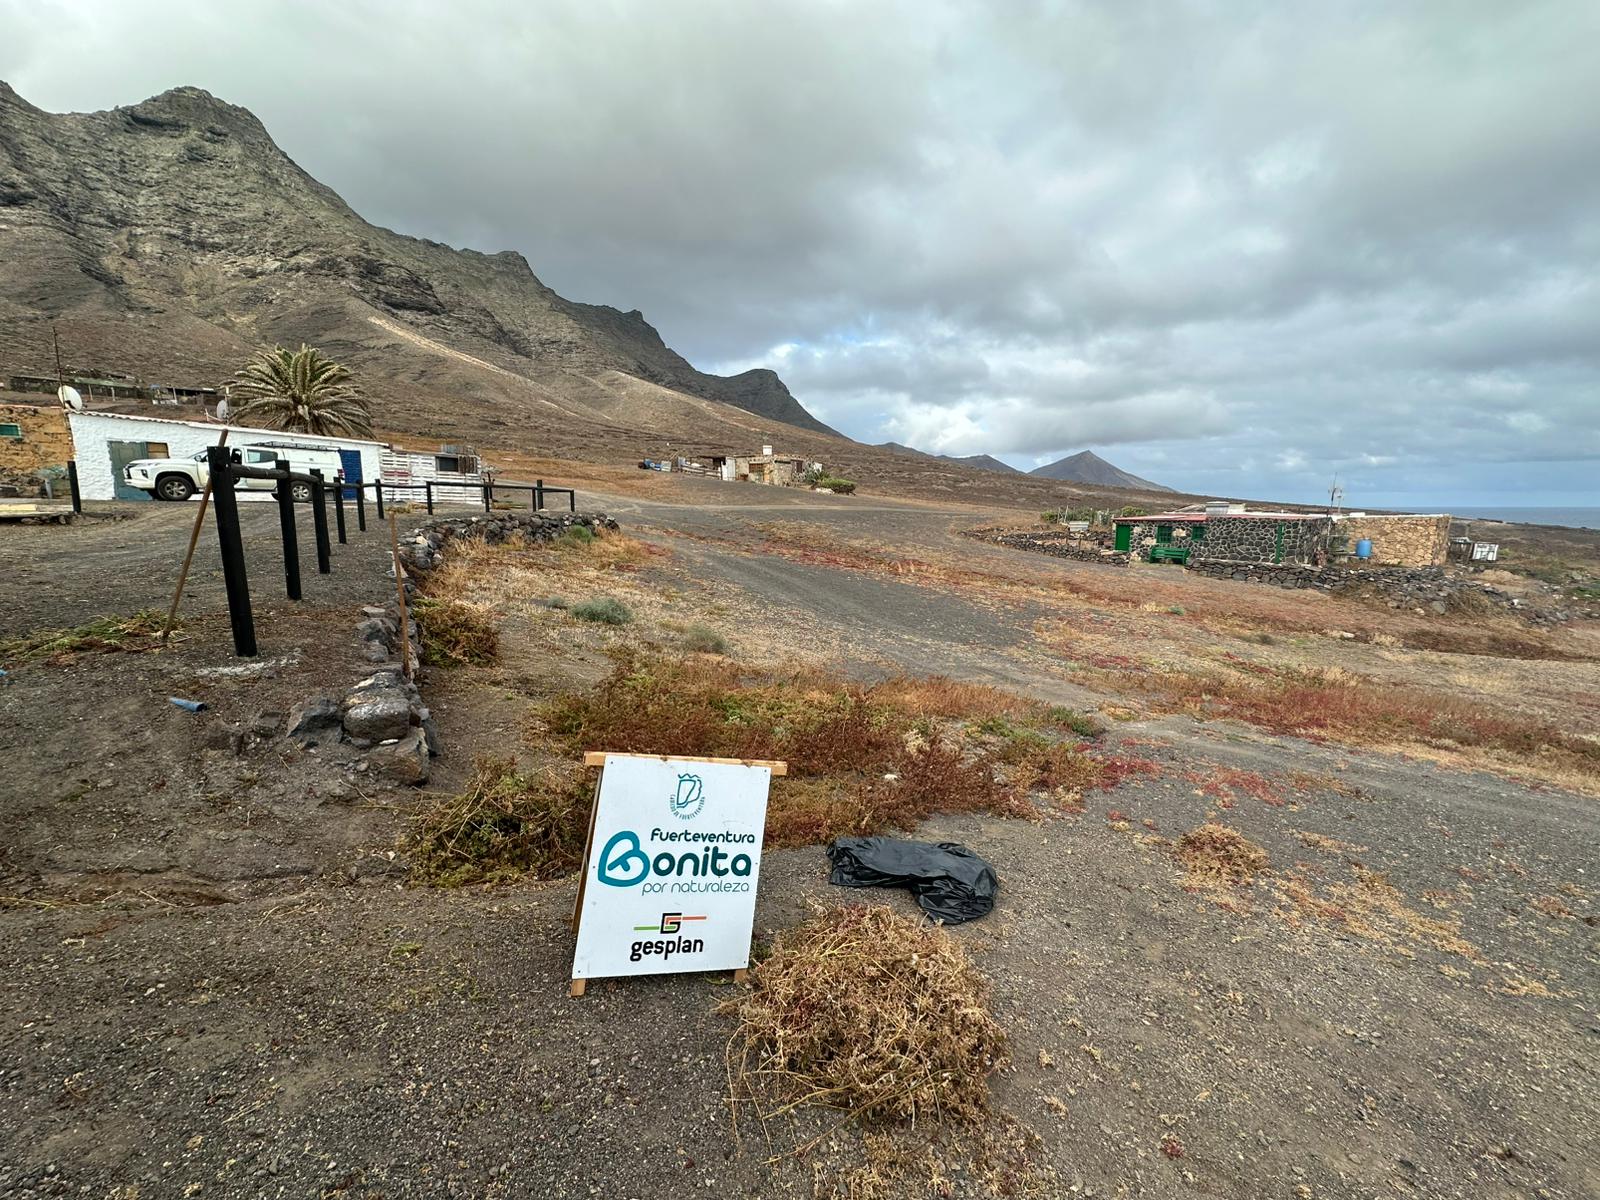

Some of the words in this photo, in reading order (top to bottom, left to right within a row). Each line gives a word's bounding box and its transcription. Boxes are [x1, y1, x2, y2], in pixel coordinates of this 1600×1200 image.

[598, 830, 751, 887] Bonita
[642, 881, 667, 896] por
[671, 880, 749, 893] naturaleza
[630, 936, 703, 961] gesplan
